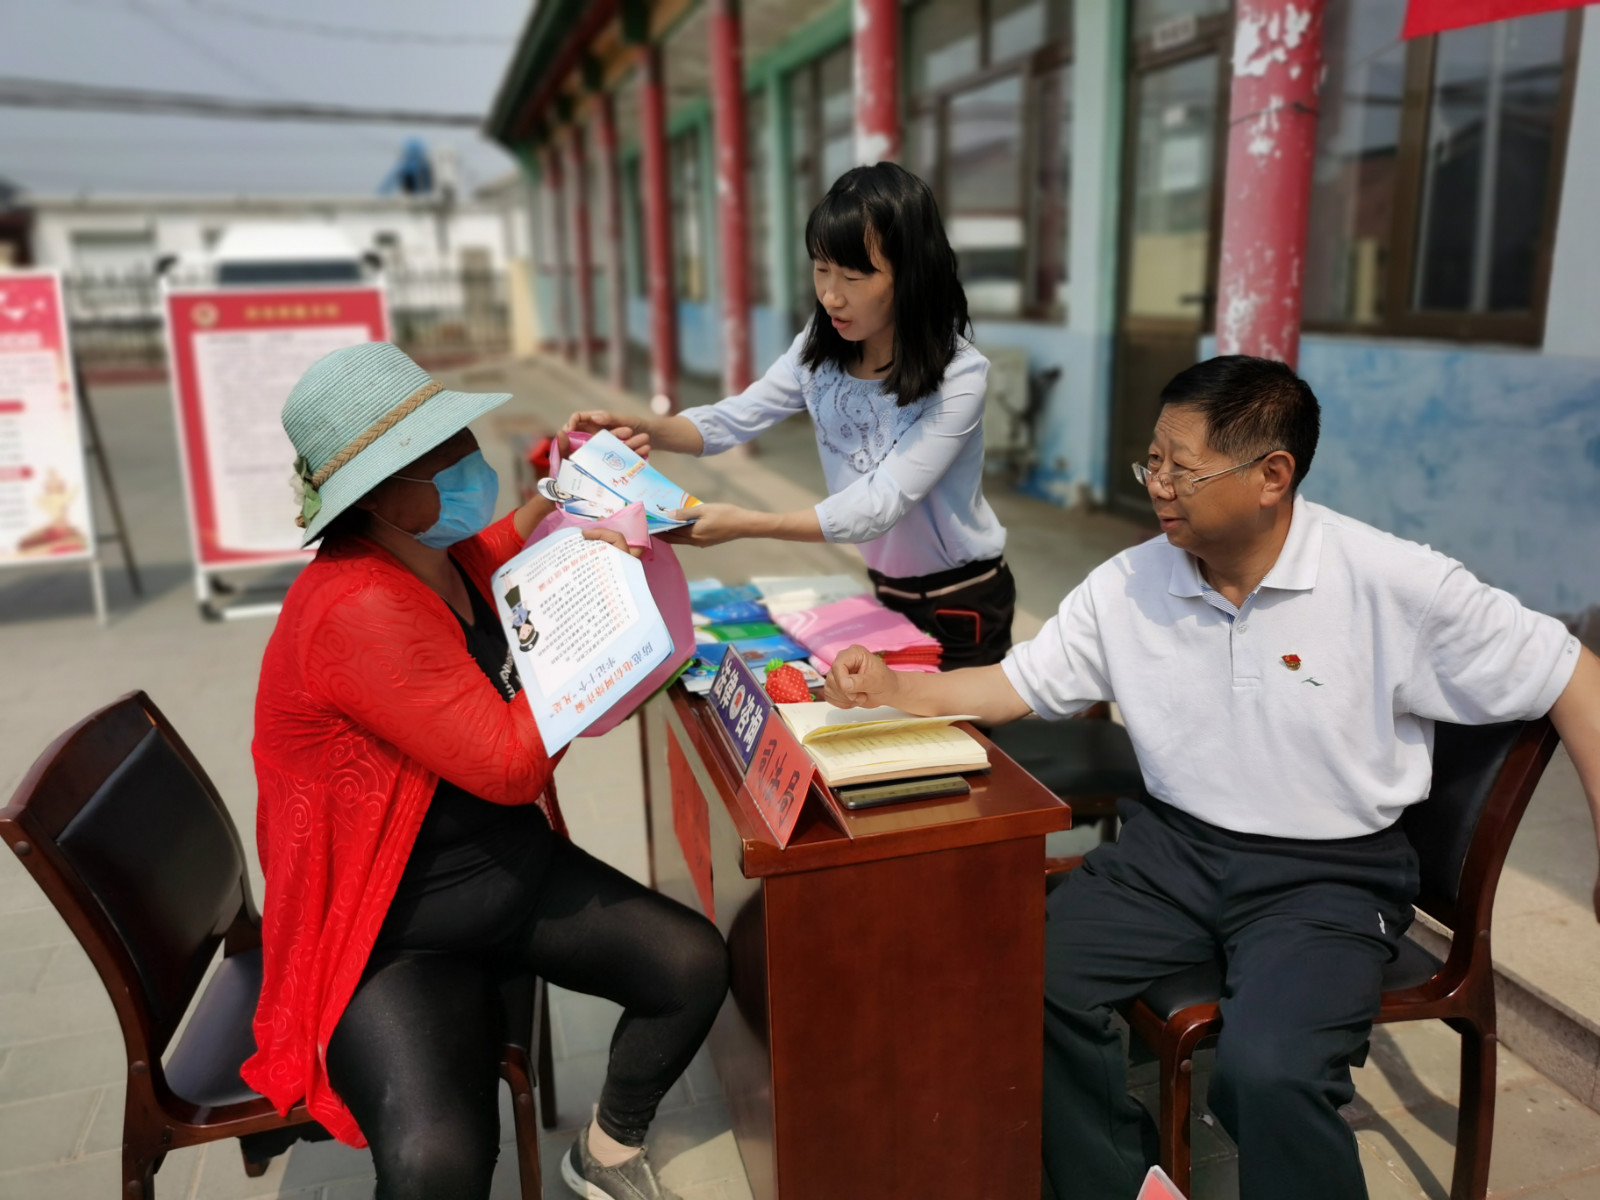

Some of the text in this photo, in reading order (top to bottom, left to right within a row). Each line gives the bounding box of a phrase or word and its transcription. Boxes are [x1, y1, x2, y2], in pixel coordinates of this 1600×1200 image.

[575, 641, 653, 714] 防范电信网络诈骗
[758, 738, 800, 828] 司法局
